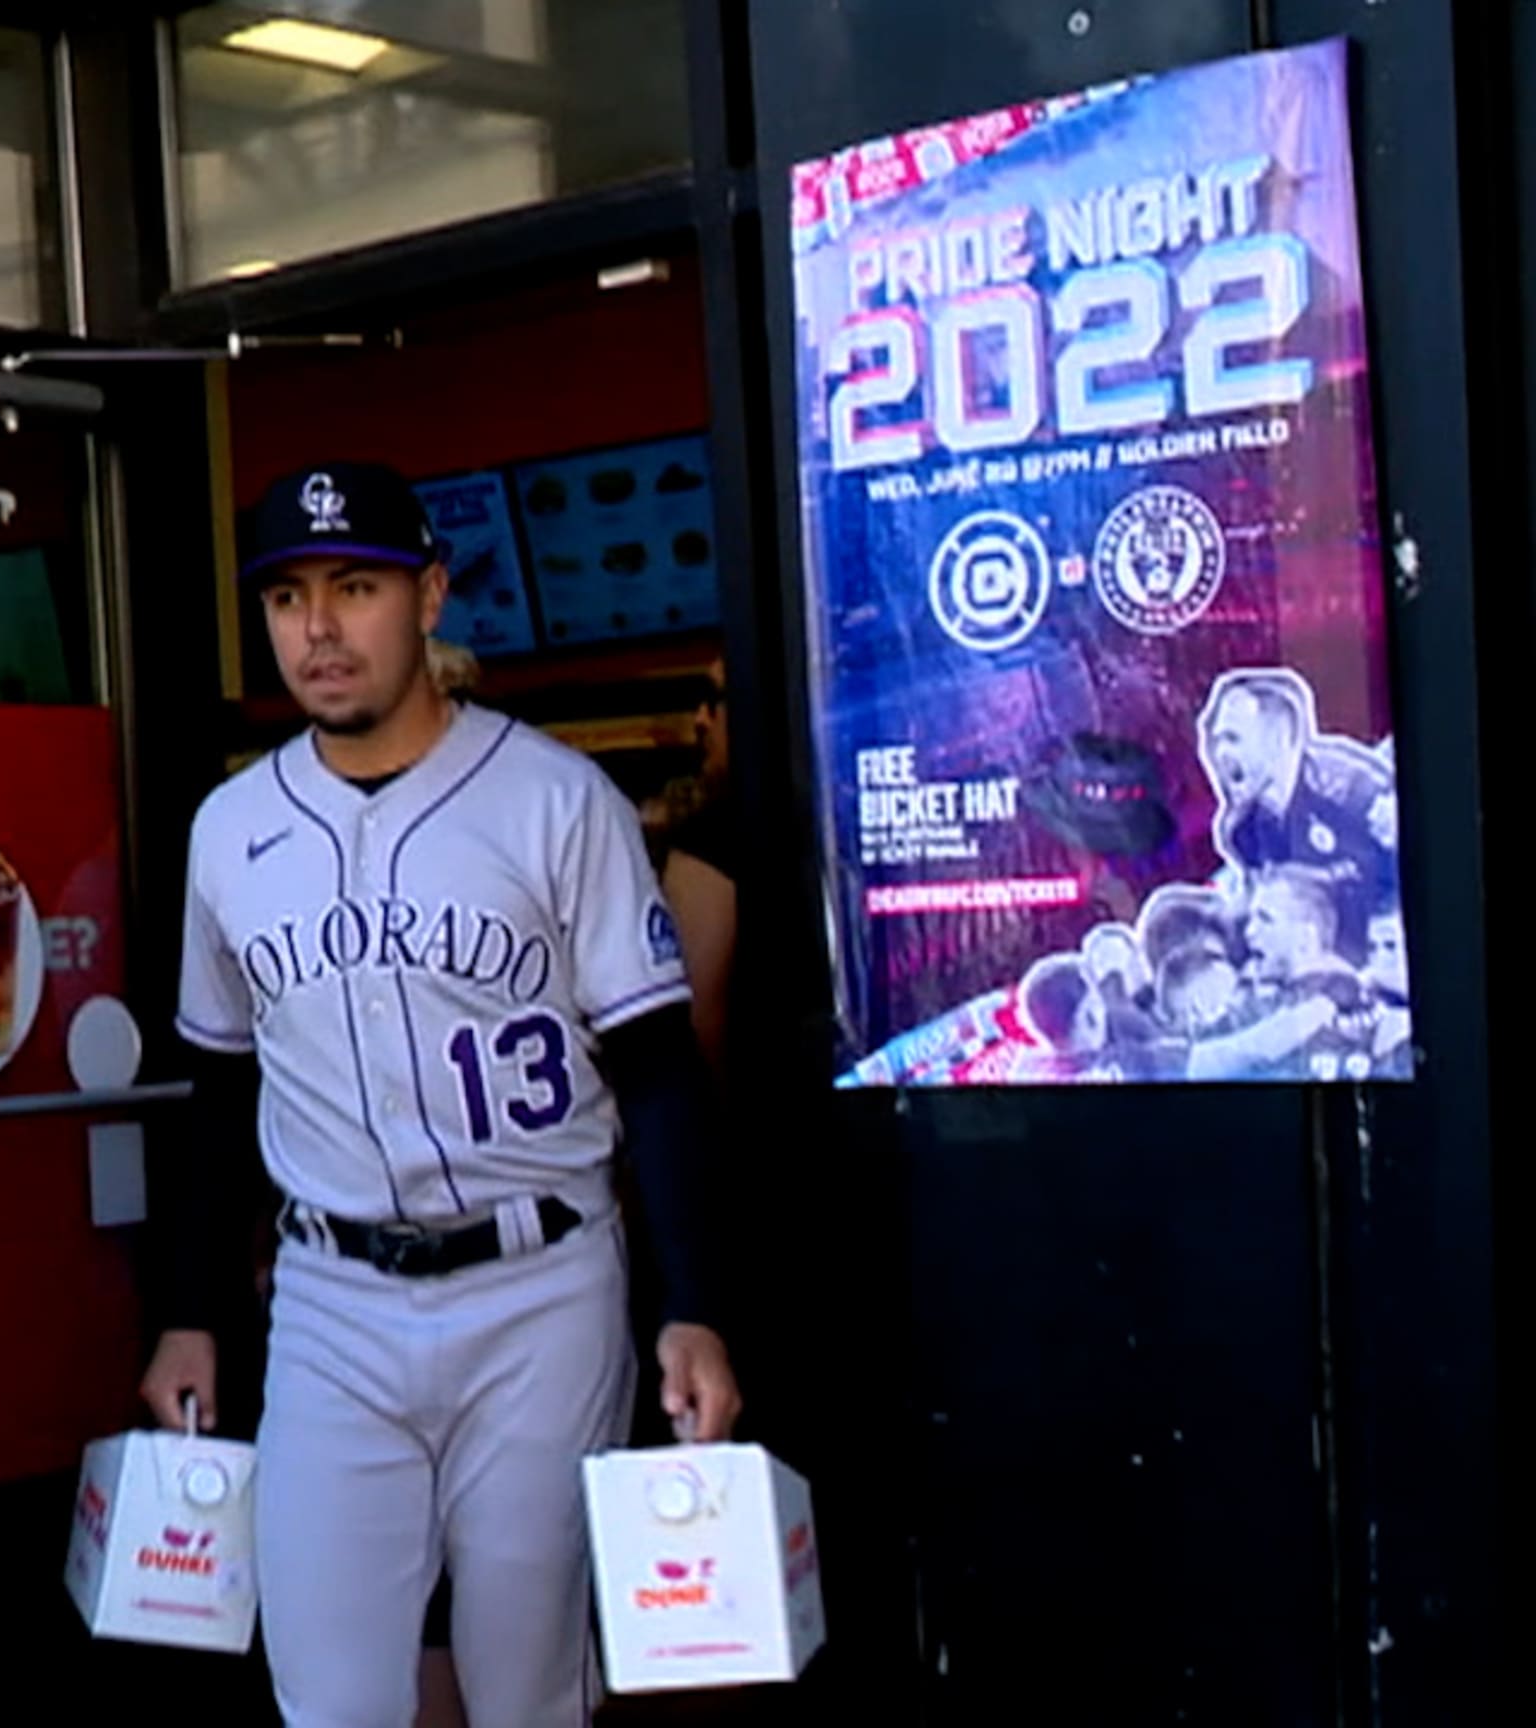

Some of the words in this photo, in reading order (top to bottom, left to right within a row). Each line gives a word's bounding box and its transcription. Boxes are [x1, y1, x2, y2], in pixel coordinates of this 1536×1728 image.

[849, 208, 1034, 302] PRIDE
[1046, 155, 1270, 268] NIGHT
[829, 233, 1312, 469] 2022
[964, 777, 1020, 821] HAT
[245, 898, 552, 1022] OLORADO
[447, 1012, 574, 1144] 13
